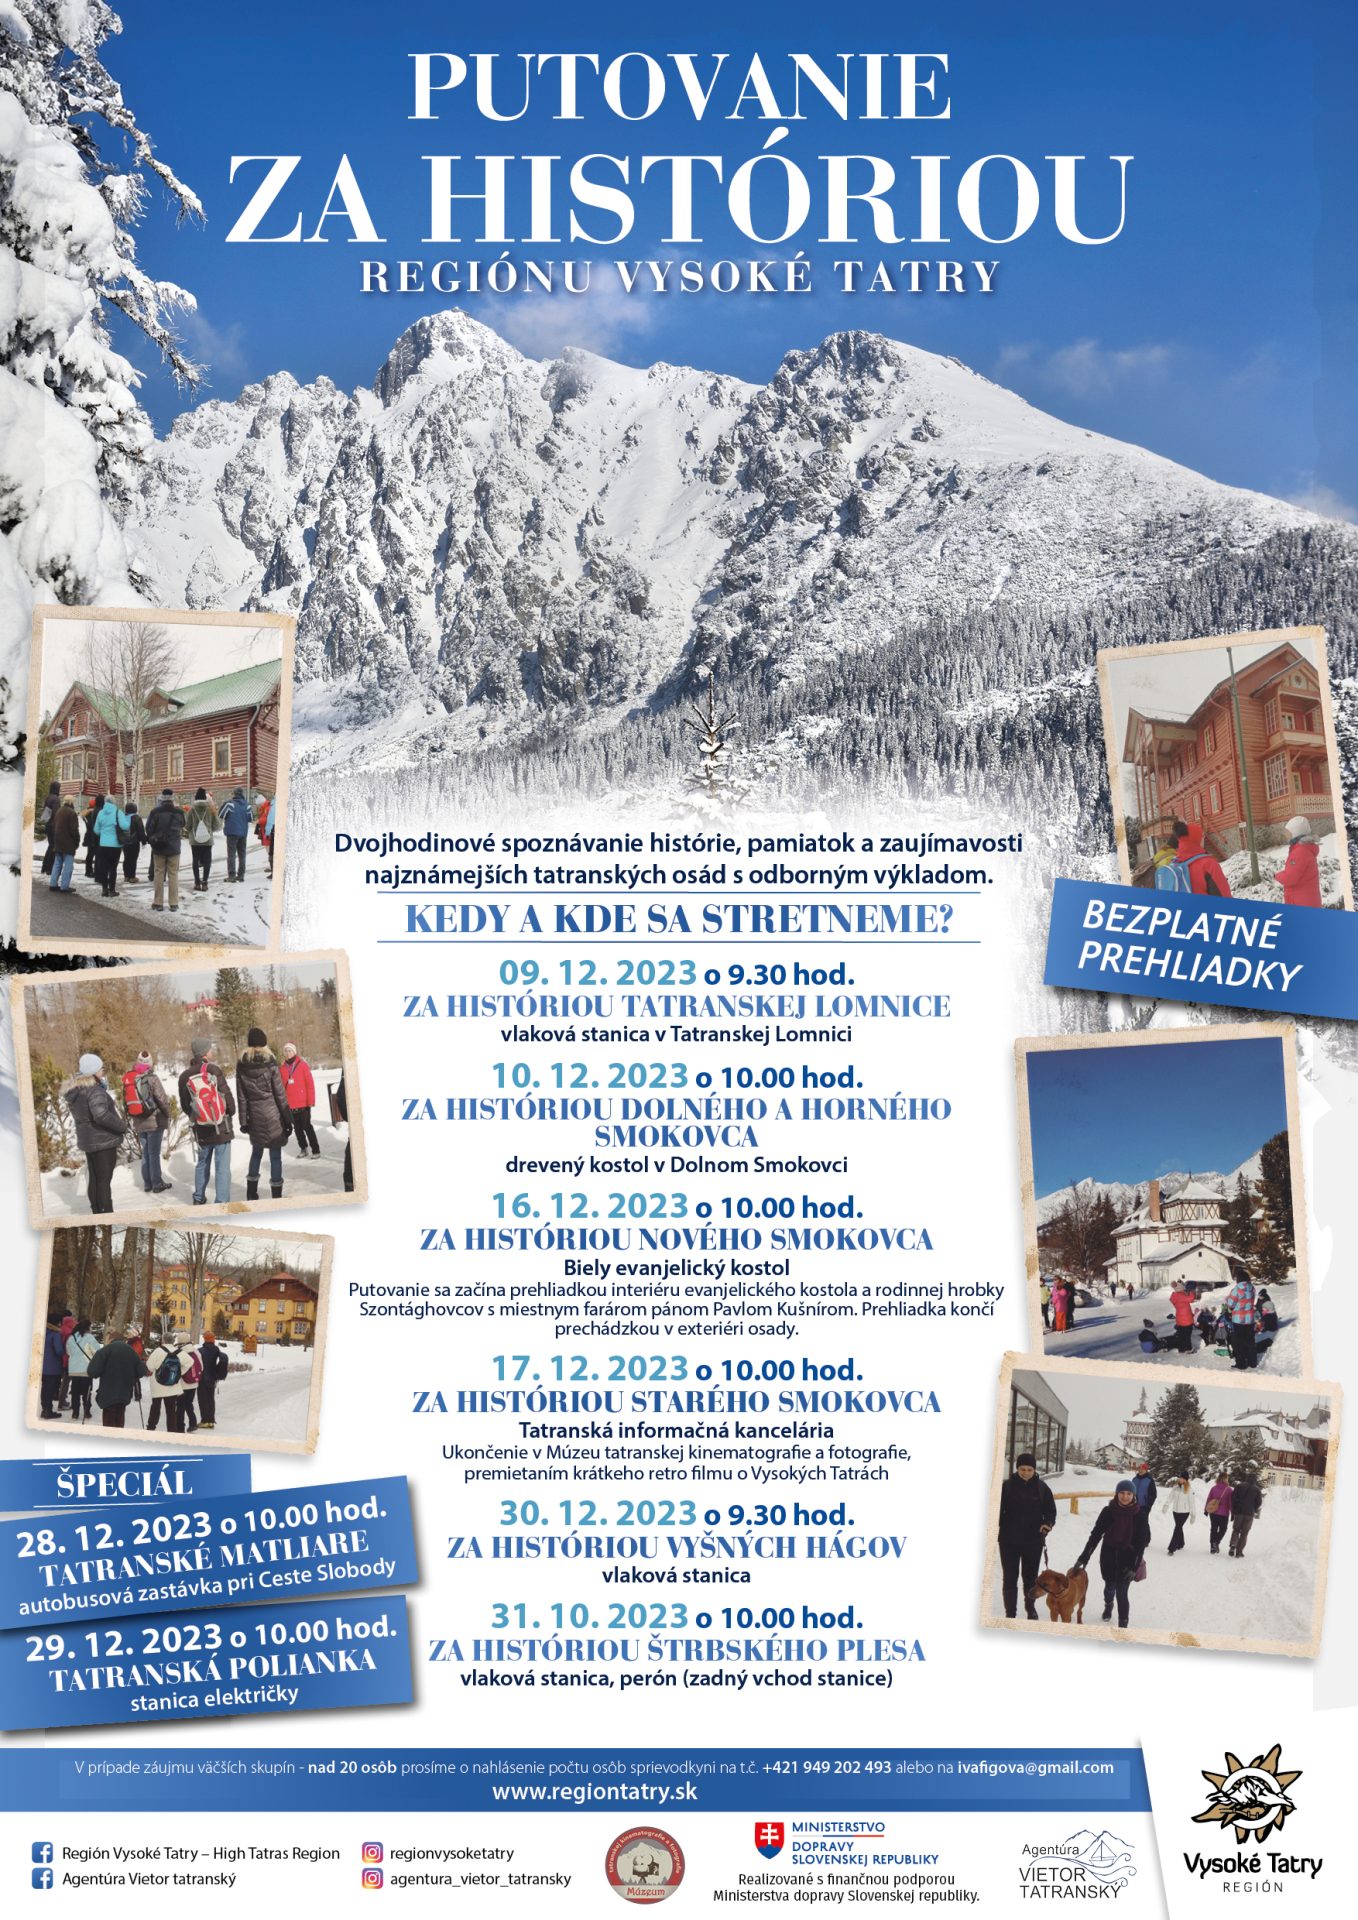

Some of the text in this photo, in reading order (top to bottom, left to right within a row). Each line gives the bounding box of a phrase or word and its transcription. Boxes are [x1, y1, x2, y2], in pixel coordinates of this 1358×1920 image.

[408, 52, 950, 121] PUTOVANIE
[225, 127, 1134, 245] ZA HISTÓRIOU
[364, 252, 998, 297] REGIÓNU VYSOKÉ TATRY
[336, 832, 1022, 857] Dvojhodinové spoznávanie histórie, pamiatok a zaujímavosti
[366, 864, 993, 889] najznámejších tatranských osád s odborným výkladom.
[406, 904, 953, 933] KEDY A KDE SA STRETNEME?
[1083, 900, 1282, 949] BEZPLATNÉ
[500, 960, 854, 985] 09. 12. 2023 o 9.30 hod.
[1078, 941, 1303, 991] PREHLIADKY
[404, 990, 950, 1019] ZA HISTÓRIOU TATRANSKEJ LOMNICE
[501, 1025, 851, 1046] vlaková stanica v Tatranskej Lomnici
[493, 1063, 863, 1088] 10. 12. 2023 o 10.00 hod.
[402, 1092, 951, 1120] ZA HISTÓRIOU DOLNÉHO A HORNÉHO
[595, 1125, 758, 1147] SMOKOVCA
[519, 1421, 833, 1438] Tatranská informačná kancelária
[443, 1444, 911, 1463] Ukončenie v Múzeu tatranskej kinematografie a fotografie,
[56, 1464, 193, 1499] ŠPECIÁL
[16, 1495, 386, 1558] 28. 12. 2023 o 10.00 hod.
[39, 1530, 368, 1586] TATRANSKÉ MATLIARE
[20, 1558, 395, 1615] autobusová zastávka pri Ceste Slobody
[492, 1603, 863, 1628] 31. 10. 2023 o 10.00 hod.
[429, 1633, 925, 1661] ZA HISTÓRIOU ŠTRBSKÉHO PLESA
[49, 1649, 376, 1691] TATRANSKÁ POLIANKA
[460, 1669, 892, 1690] vlaková stanica, perón (zadný vchod stanice)
[131, 1685, 298, 1711] stanica električky
[75, 1760, 1114, 1776] V prípade záujmu väčších skupín nad 20 osôb prosíme o nahlásenie počtu osôb sprievodkyni na t.č. +421 949 202 493 alebo na ivafigova@gmail.com
[492, 1781, 698, 1804] www.regiontatry.sk
[793, 1822, 885, 1832] MINISTERSTVO
[63, 1847, 339, 1862] Región Vysoké Tatry High Tatras Region
[391, 1847, 514, 1862] regionvysoketatry
[793, 1842, 854, 1851] DOPRAVY
[1022, 1844, 1080, 1858] Agentúra
[792, 1855, 939, 1867] SLOVENSKEJ REPUBLIKY
[1183, 1852, 1323, 1879] Vysoké Tatry
[63, 1873, 236, 1888] Agentúra Vietor tatranský
[391, 1873, 571, 1888] agentura_vietor_tatransky
[739, 1872, 954, 1888] Realizované s finančnou podporou
[1019, 1867, 1087, 1882] VIETOR
[1224, 1880, 1282, 1892] REGIÓN
[627, 1887, 666, 1897] Múzeum
[714, 1887, 979, 1904] Ministerstva dopravy Slovenskej republiky.
[1019, 1882, 1122, 1899] TATRANSKÝ
